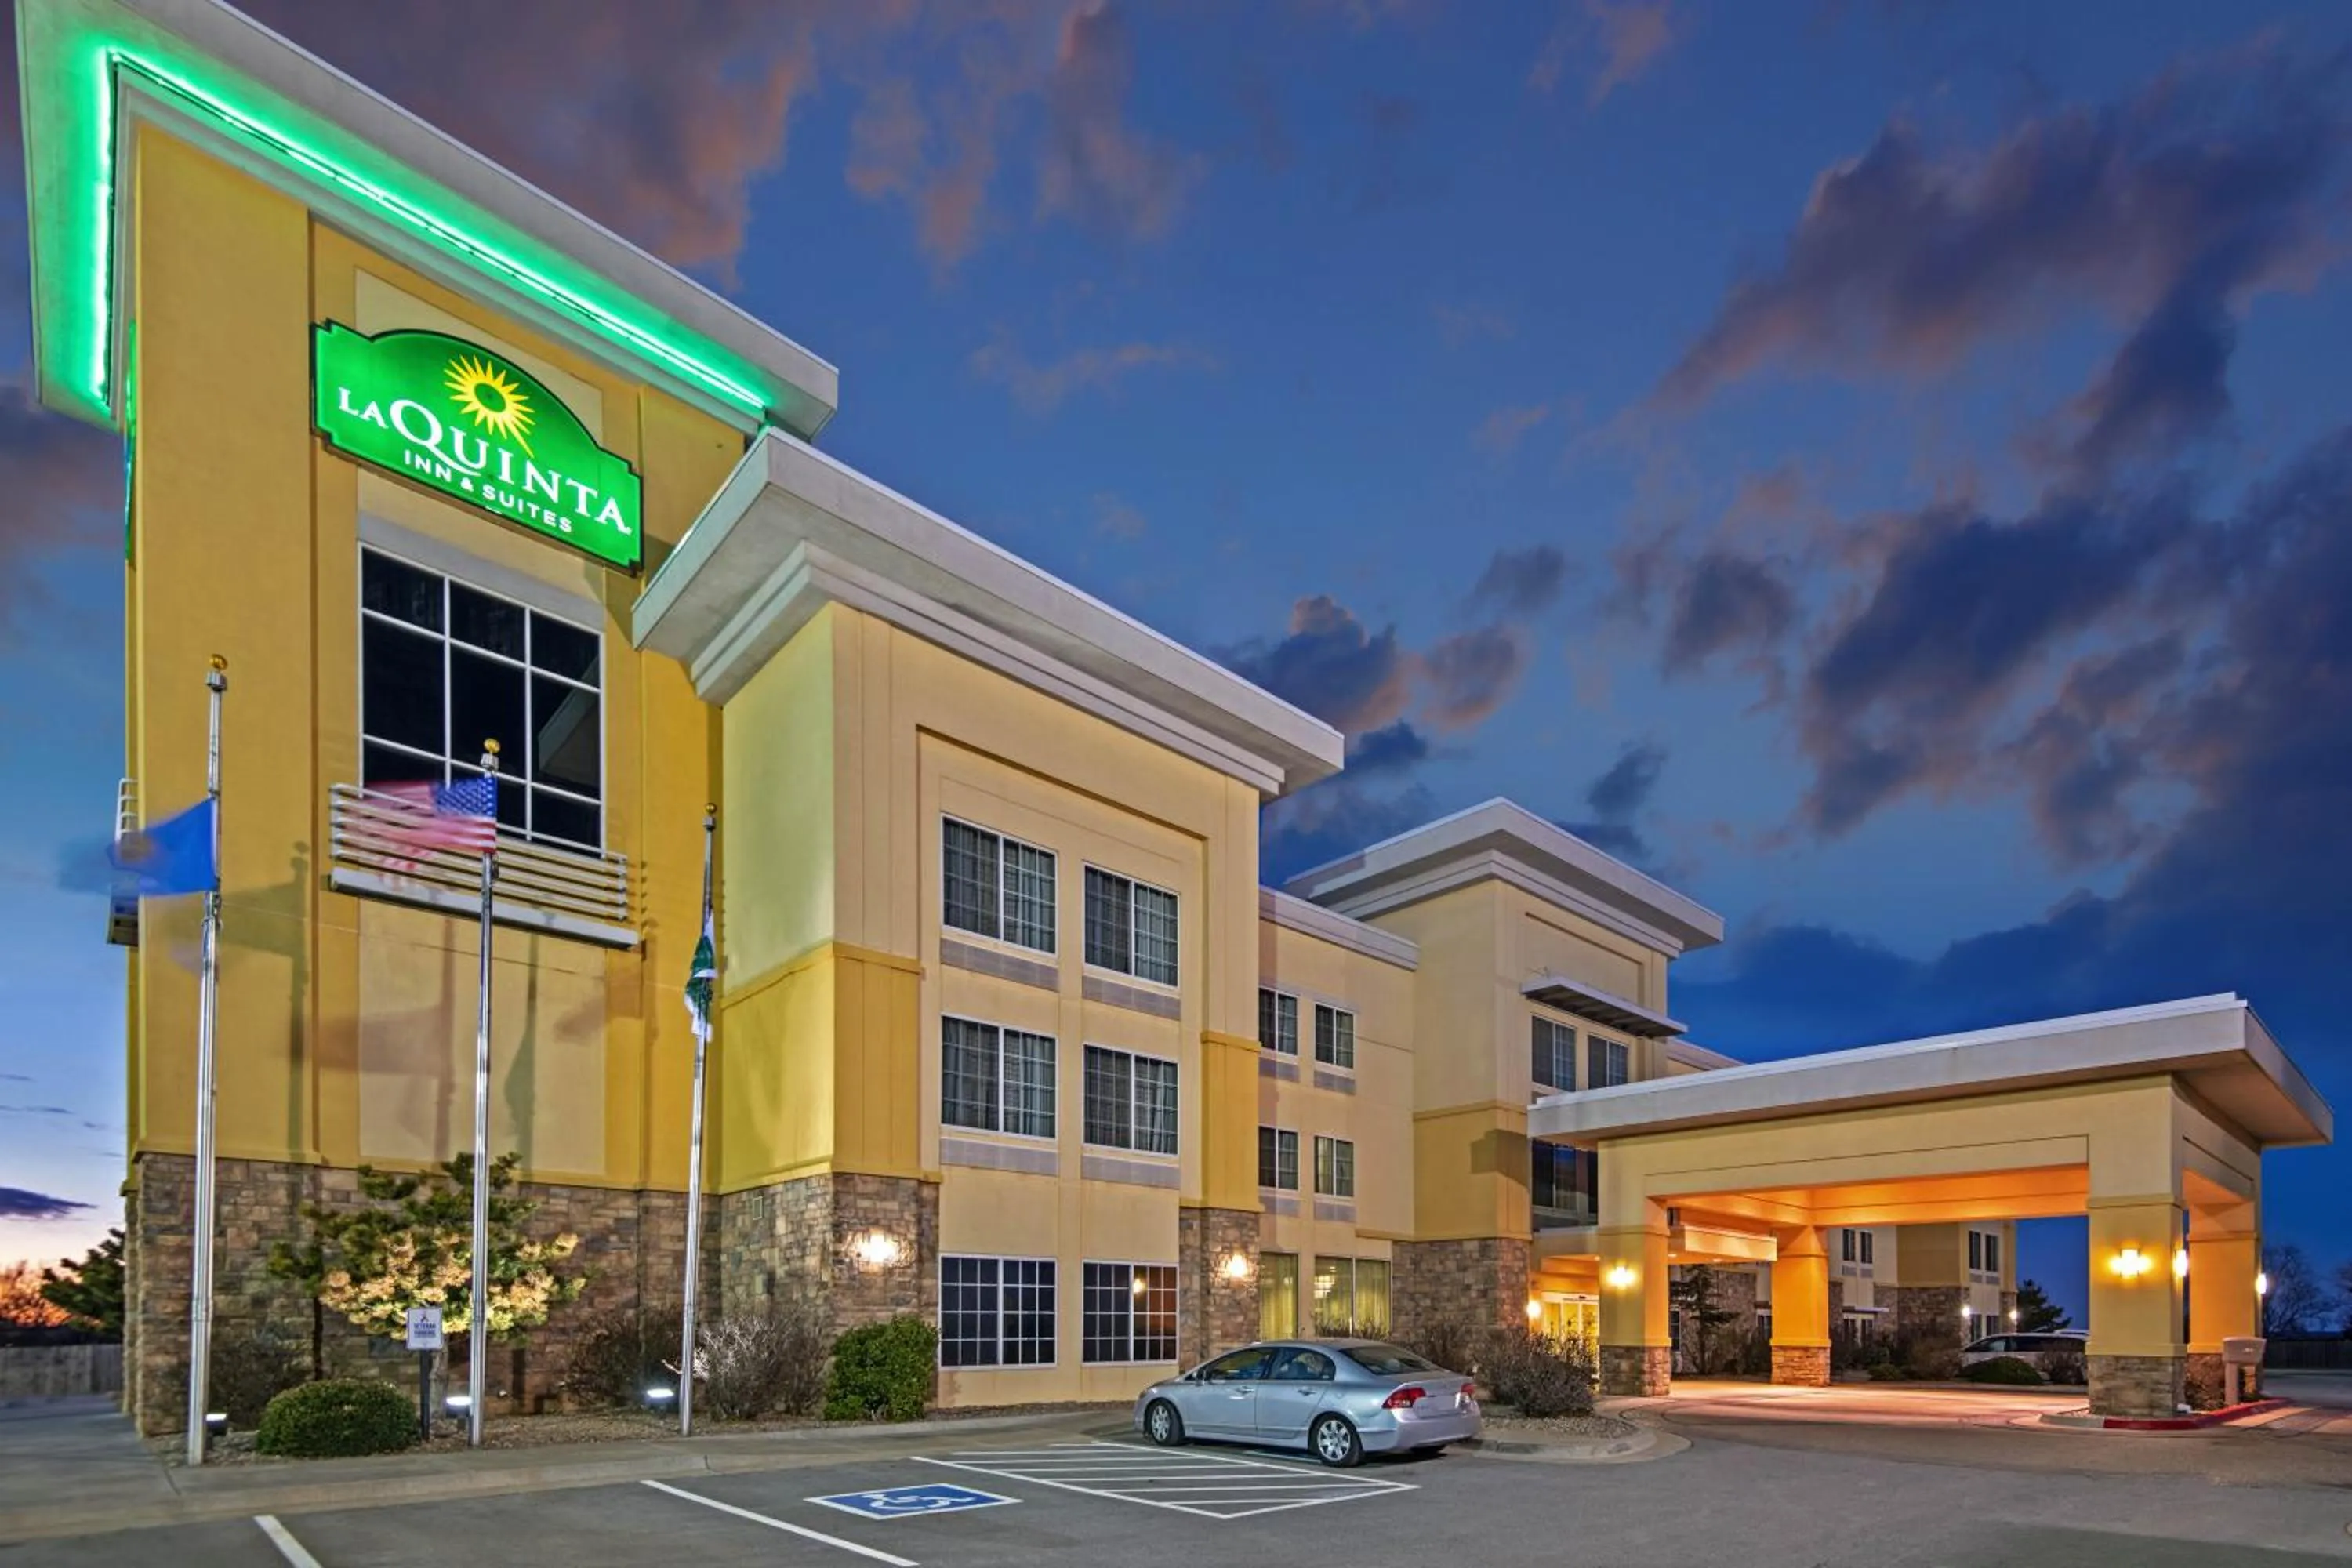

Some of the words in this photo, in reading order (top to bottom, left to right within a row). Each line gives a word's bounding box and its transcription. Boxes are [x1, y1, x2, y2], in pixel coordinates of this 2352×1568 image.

[405, 449, 452, 483] INN
[460, 477, 474, 492] &
[482, 485, 572, 533] SUITES
